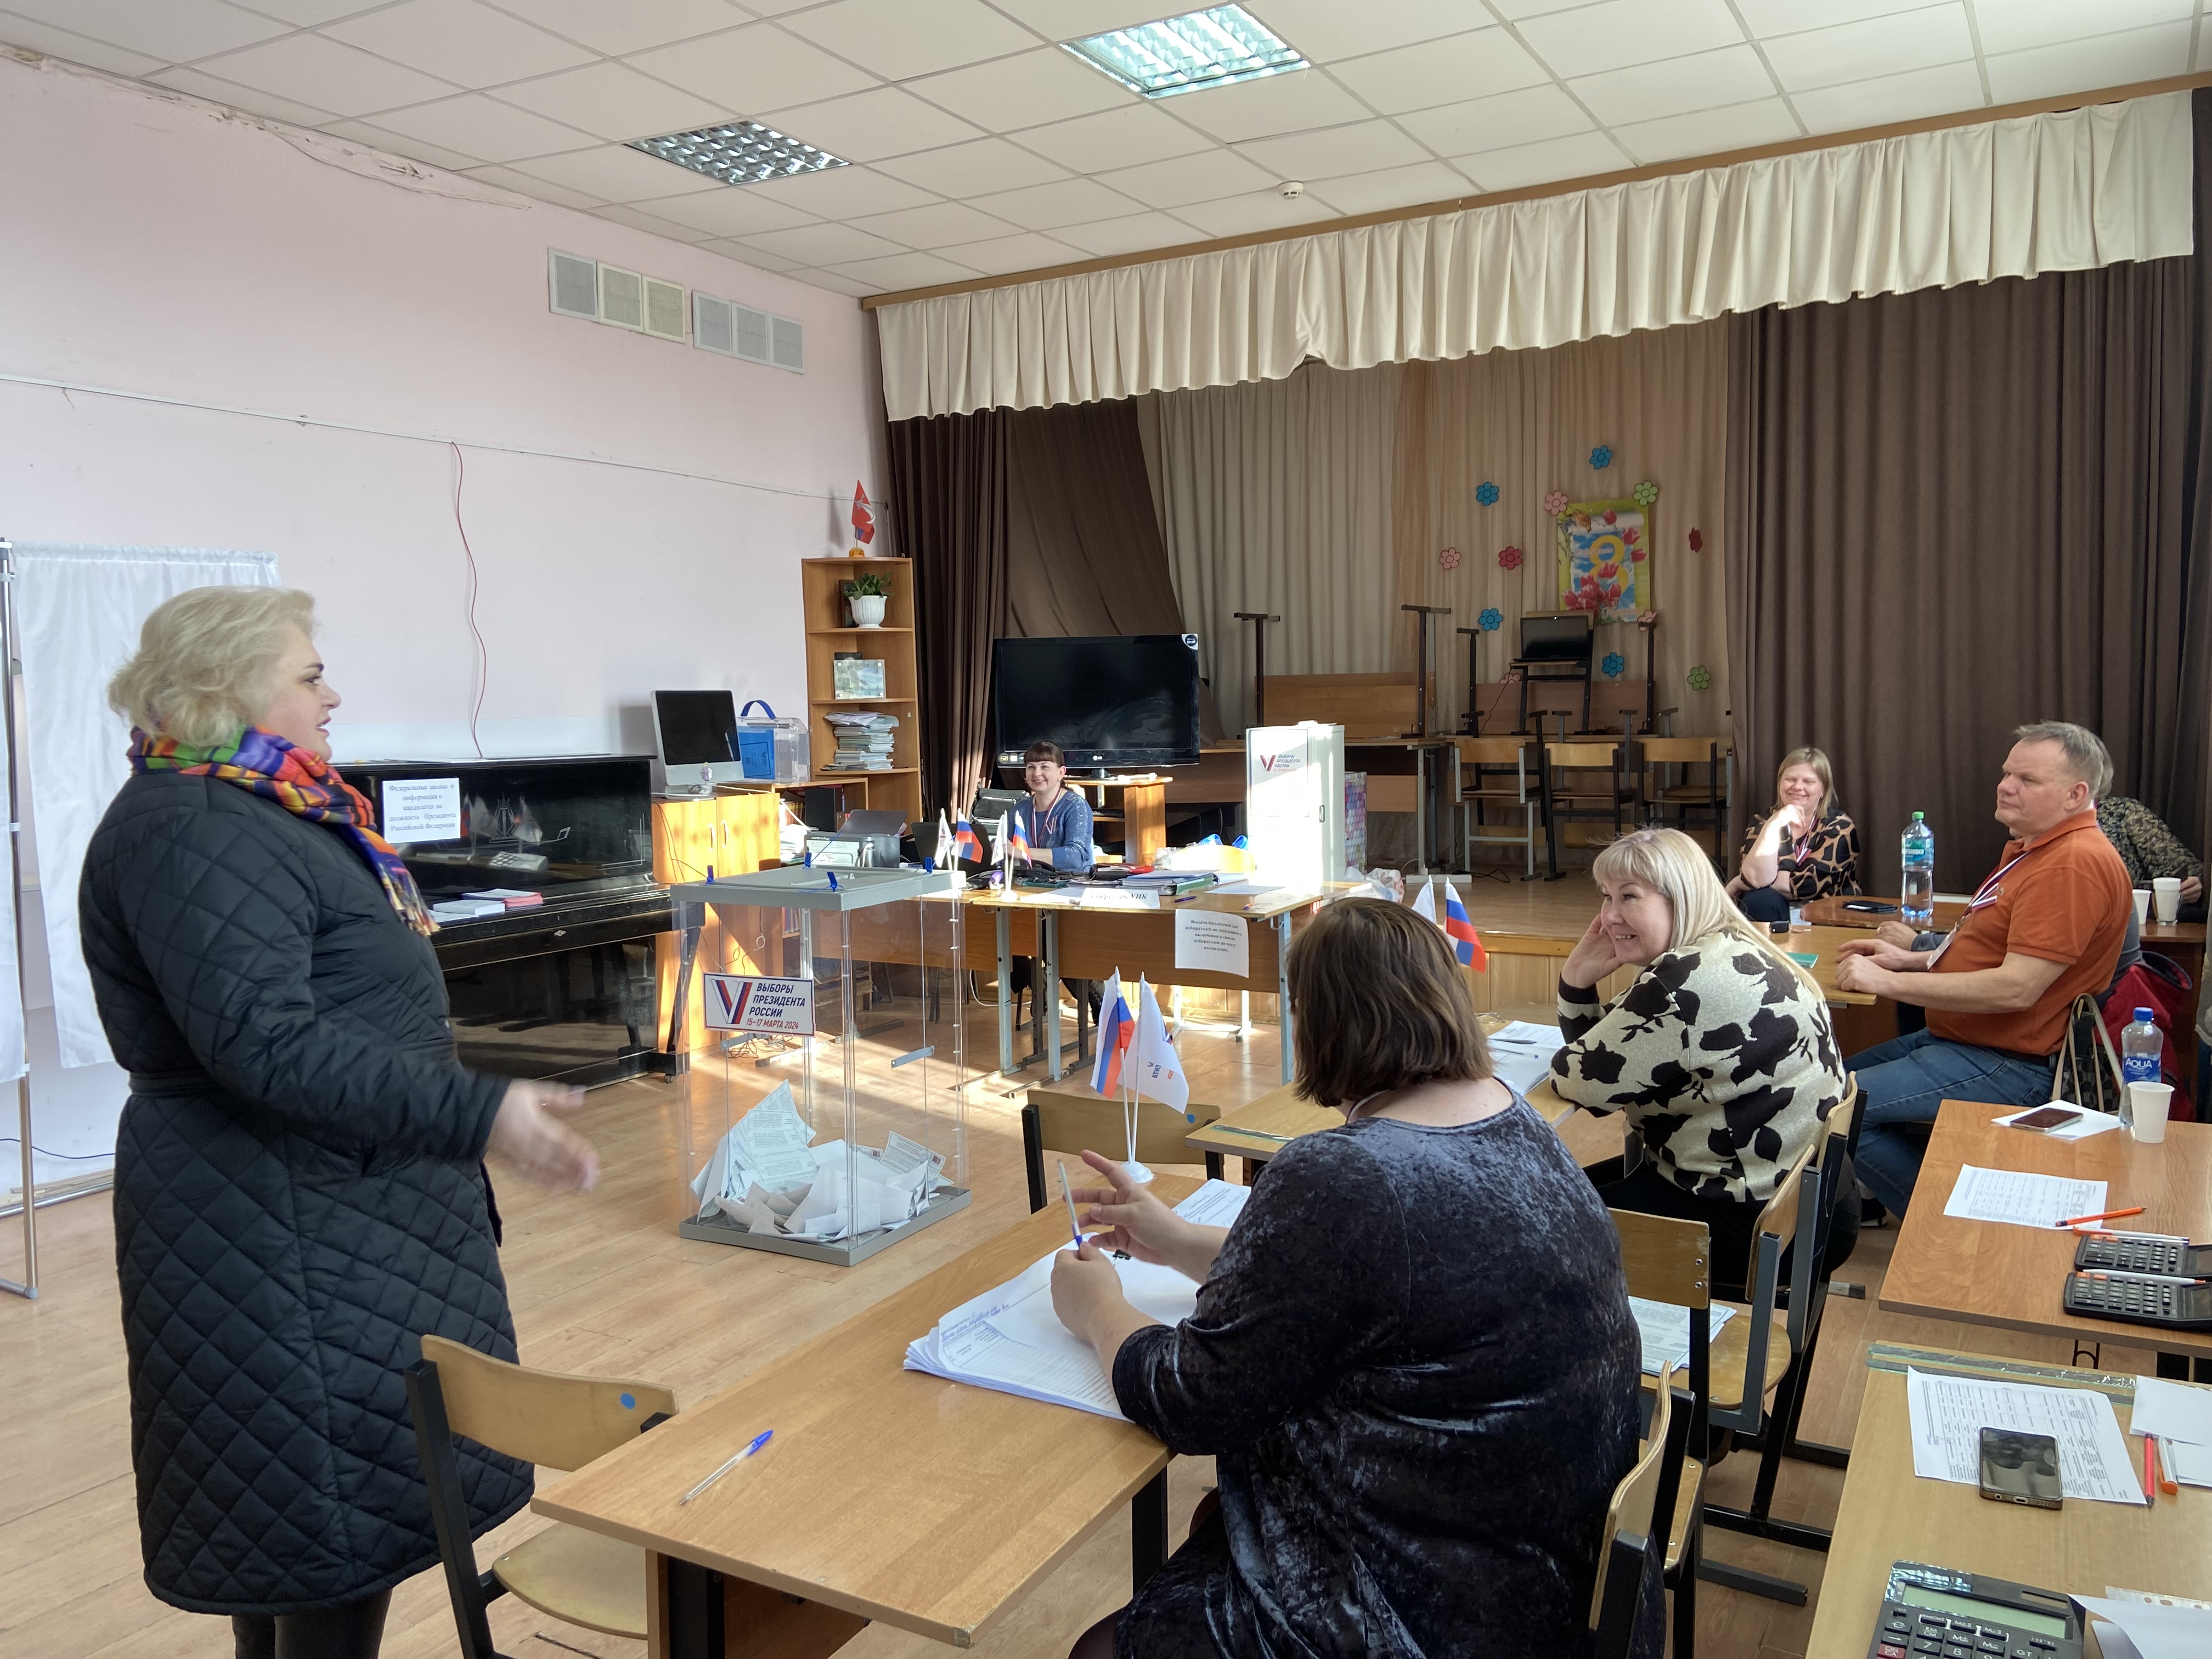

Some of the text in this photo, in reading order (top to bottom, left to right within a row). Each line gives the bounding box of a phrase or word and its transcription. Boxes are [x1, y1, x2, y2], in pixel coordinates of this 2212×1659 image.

[757, 983, 794, 994] ВЫБОРЫ
[753, 995, 805, 1007] ПРЕЗИДЕНТА
[749, 1007, 783, 1018] РОССИИ
[785, 1021, 799, 1029] 2024
[2125, 1058, 2152, 1069] AQUA
[2016, 1649, 2033, 1657] GT
